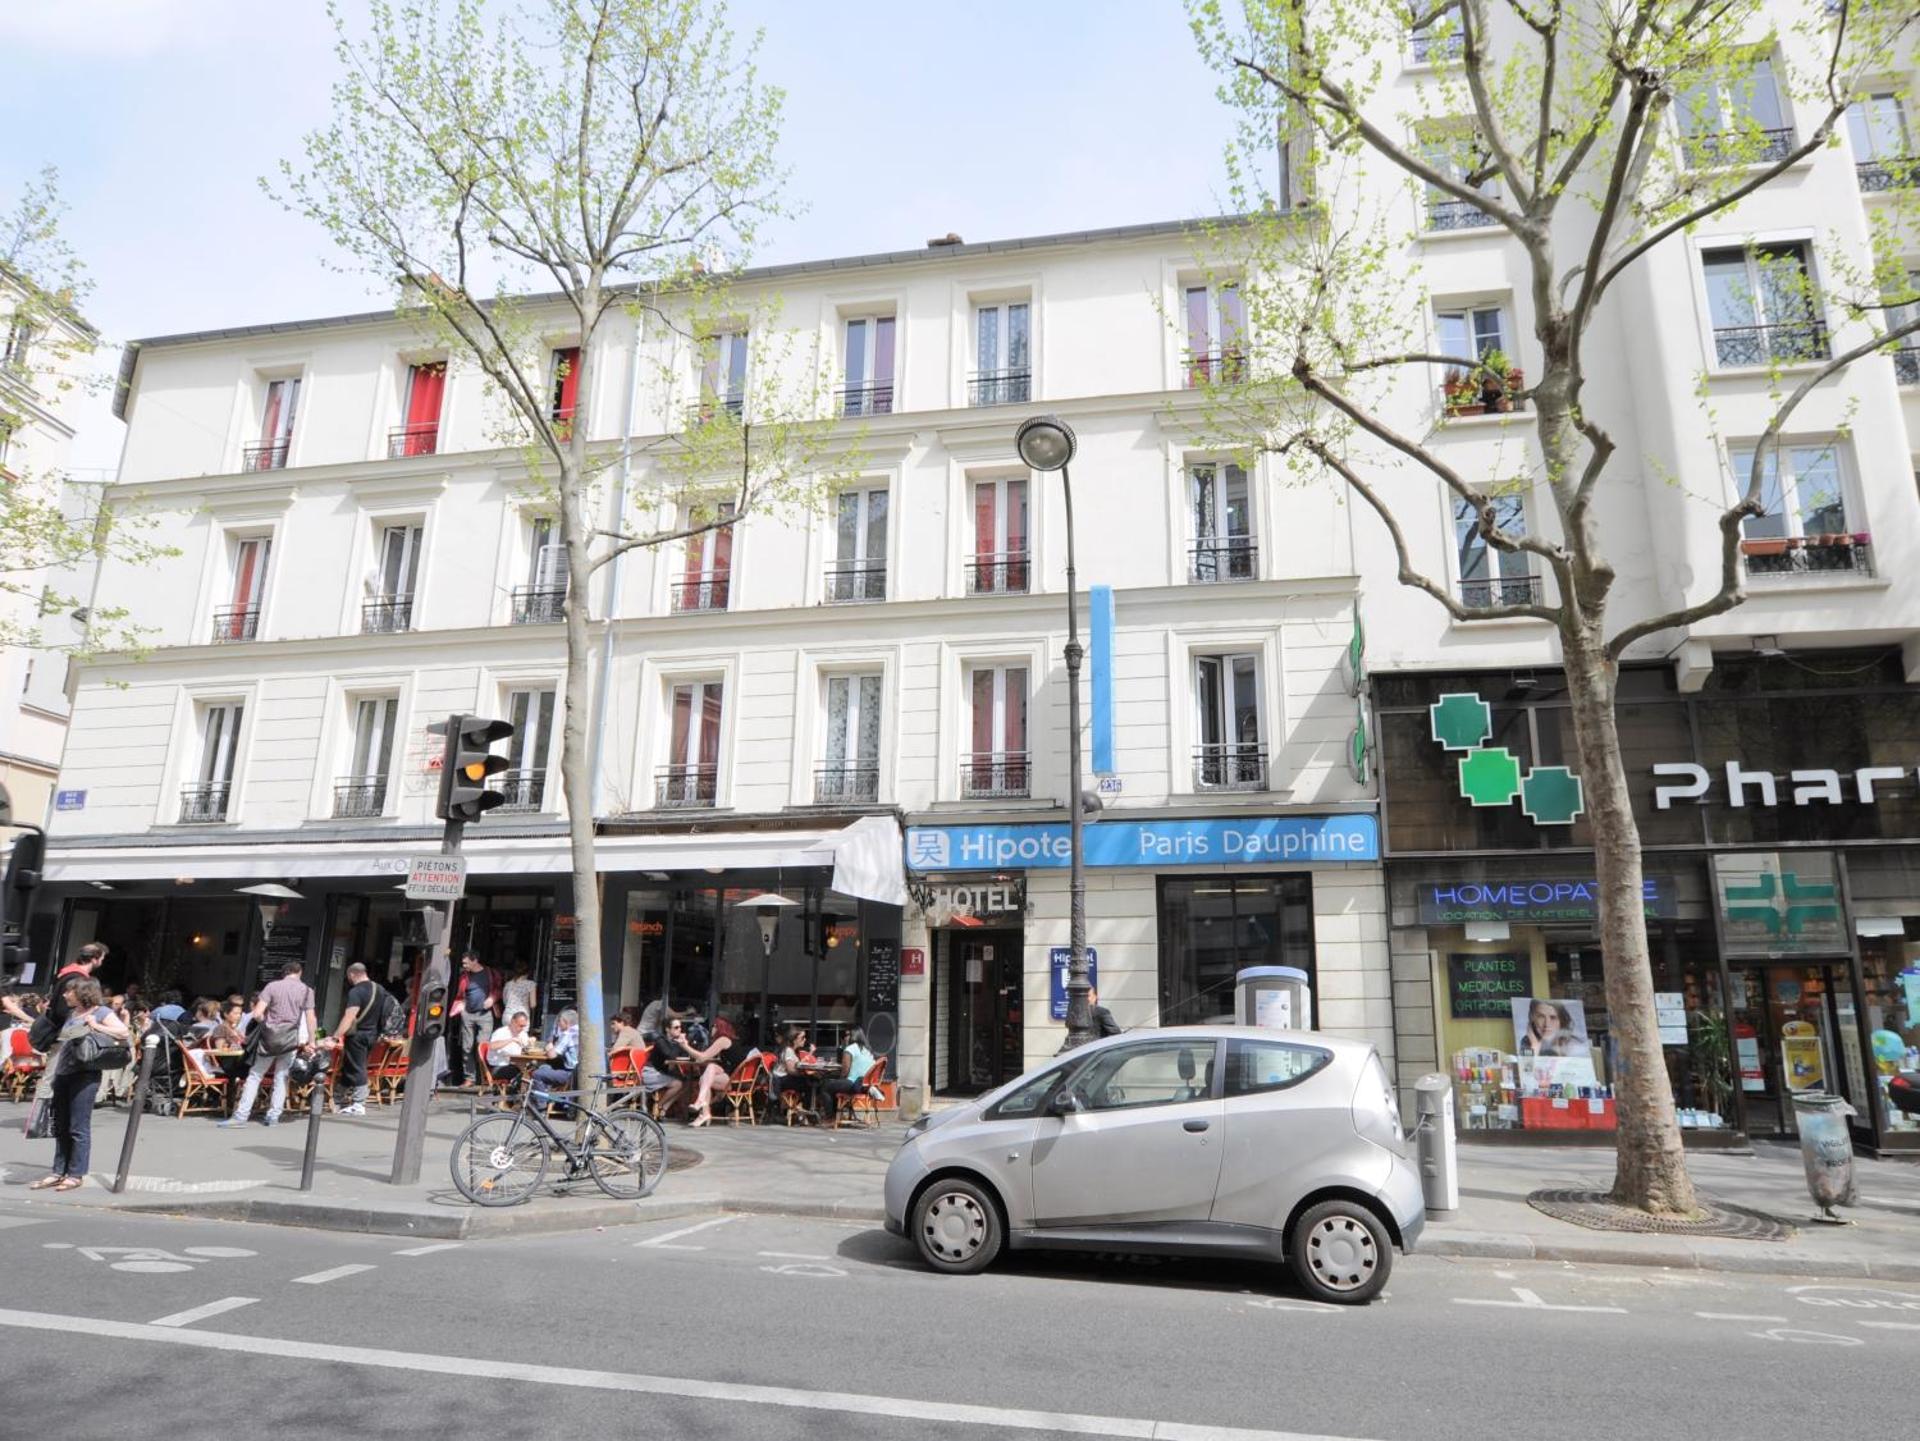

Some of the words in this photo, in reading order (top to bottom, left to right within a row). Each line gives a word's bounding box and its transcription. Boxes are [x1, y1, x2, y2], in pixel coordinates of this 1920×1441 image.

[1653, 760, 1920, 809] Phar
[961, 832, 1072, 866] Hipote
[1140, 830, 1209, 856] Paris
[1223, 828, 1365, 857] Dauphine
[417, 860, 458, 872] PIÉTONS
[412, 872, 459, 883] ATTENTION
[1434, 880, 1659, 904] HOMEOPAE
[936, 886, 1018, 912] HOTEL
[1437, 910, 1502, 920] LOCATION
[1507, 910, 1525, 919] DE
[1054, 952, 1094, 968] Hipl
[1464, 960, 1516, 972] PLANTES
[1458, 980, 1525, 993] MEDICALES
[1455, 999, 1512, 1012] ORTHOPE
